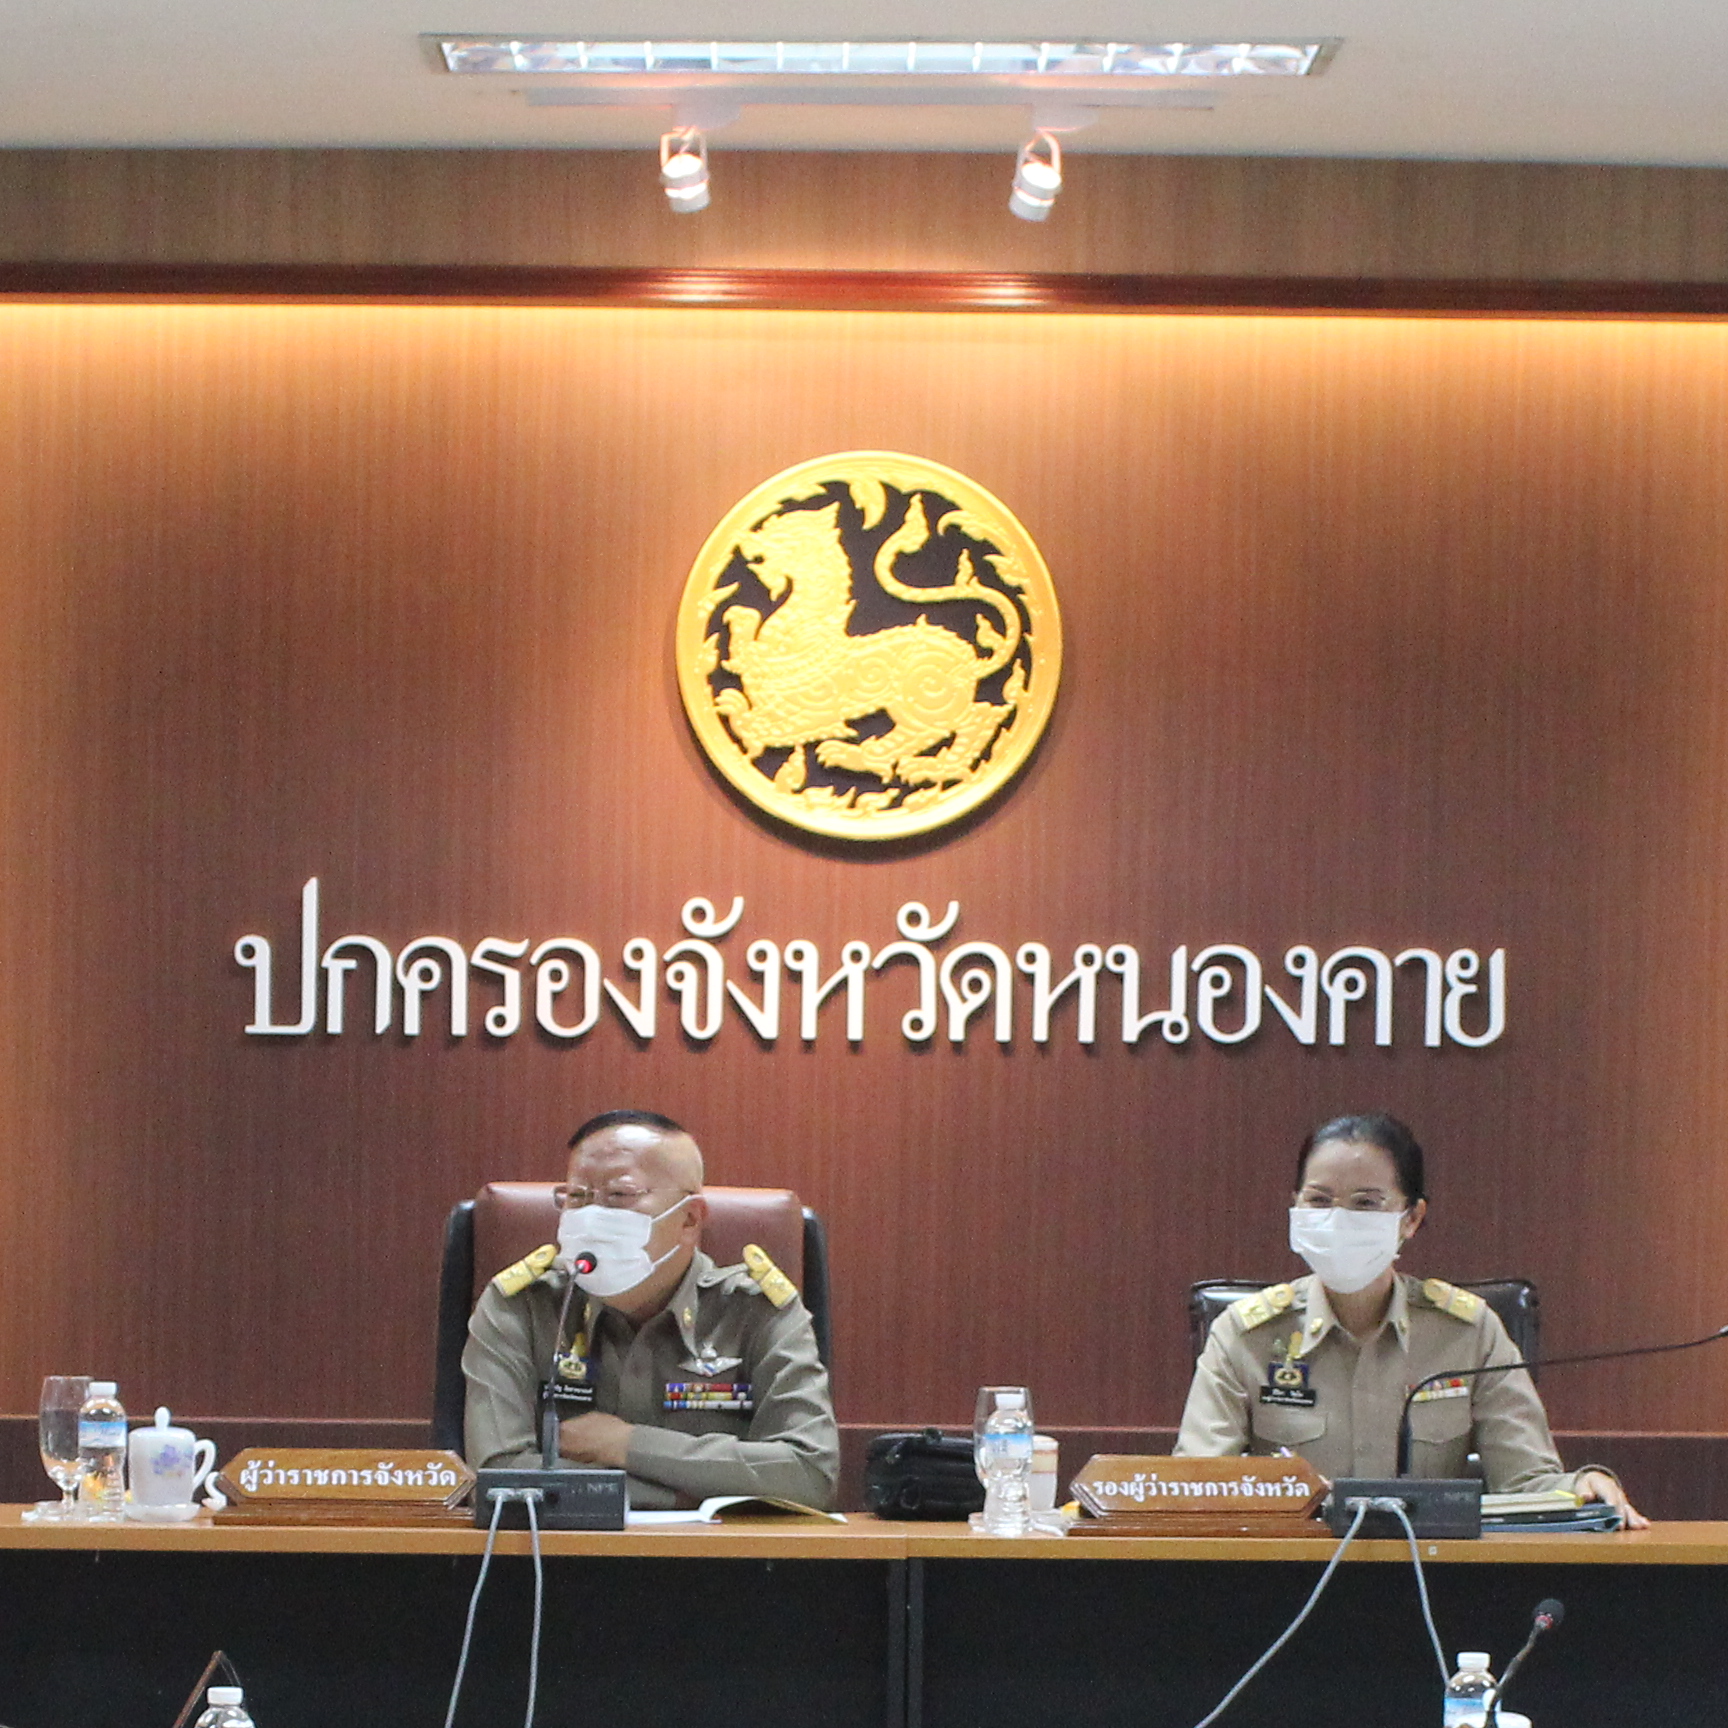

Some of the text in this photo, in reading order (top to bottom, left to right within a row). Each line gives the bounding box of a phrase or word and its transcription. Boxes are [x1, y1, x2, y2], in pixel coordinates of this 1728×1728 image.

[233, 876, 1507, 1048] ปกครองจังหวัดหนองคาย
[239, 1459, 457, 1492] ผู้ว่าราชการจังหวัด
[1092, 1472, 1310, 1503] รองผู้ว่าราชการจังหวัด
